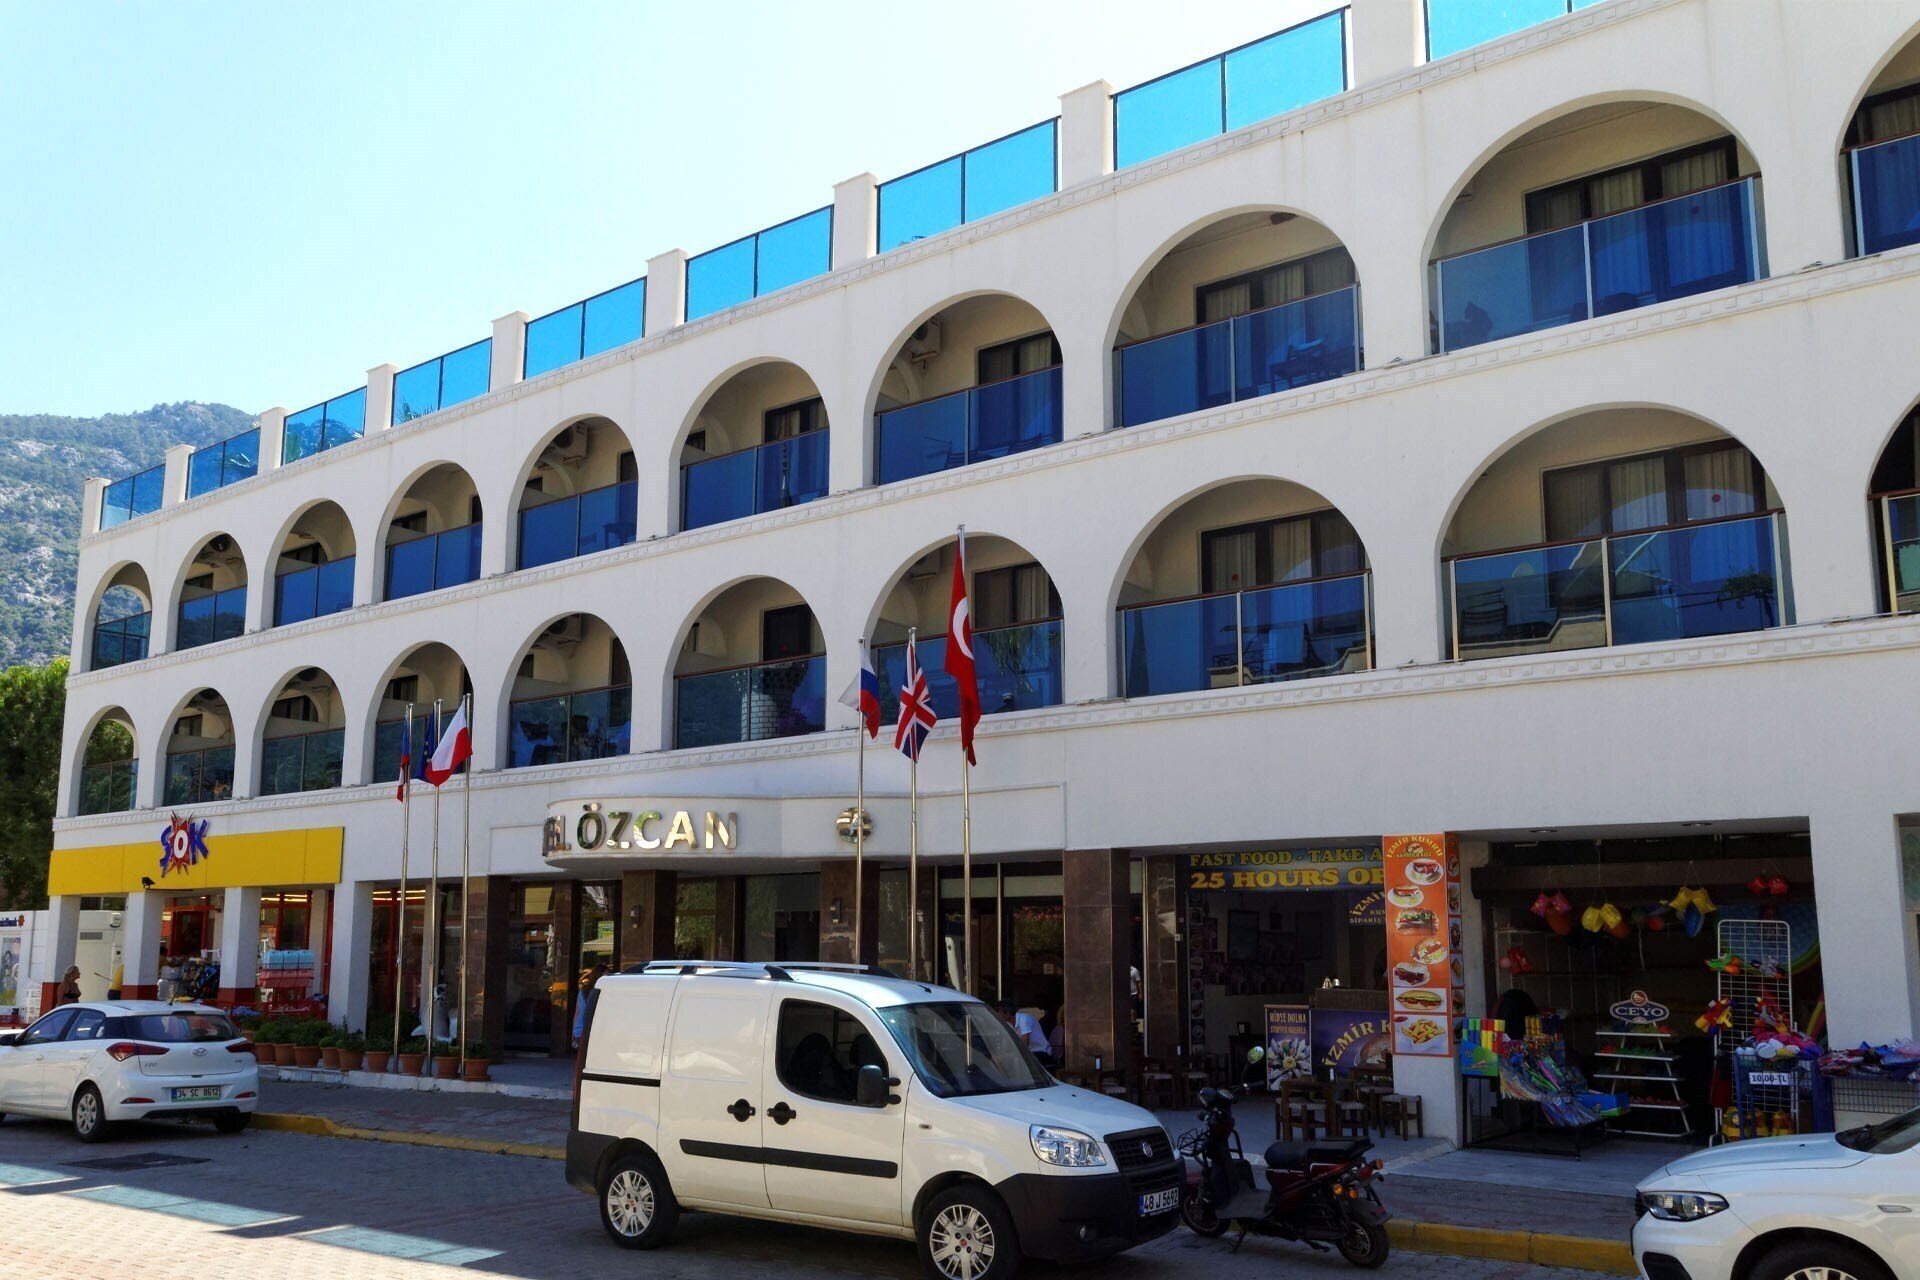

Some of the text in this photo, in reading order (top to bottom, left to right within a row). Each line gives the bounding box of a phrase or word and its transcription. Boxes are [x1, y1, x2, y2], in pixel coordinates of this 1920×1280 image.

[577, 803, 738, 850] ÖZCAN
[1190, 853, 1236, 867] FAST
[1240, 851, 1293, 866] FOOD
[1308, 848, 1363, 863] TAKE
[1369, 848, 1384, 861] A
[1190, 866, 1385, 889] 25 HOURS OP
[1615, 1006, 1665, 1017] CEYO
[1381, 1019, 1391, 1033] K
[177, 1088, 186, 1098] 34
[190, 1088, 198, 1098] SC
[1144, 1195, 1154, 1211] 48
